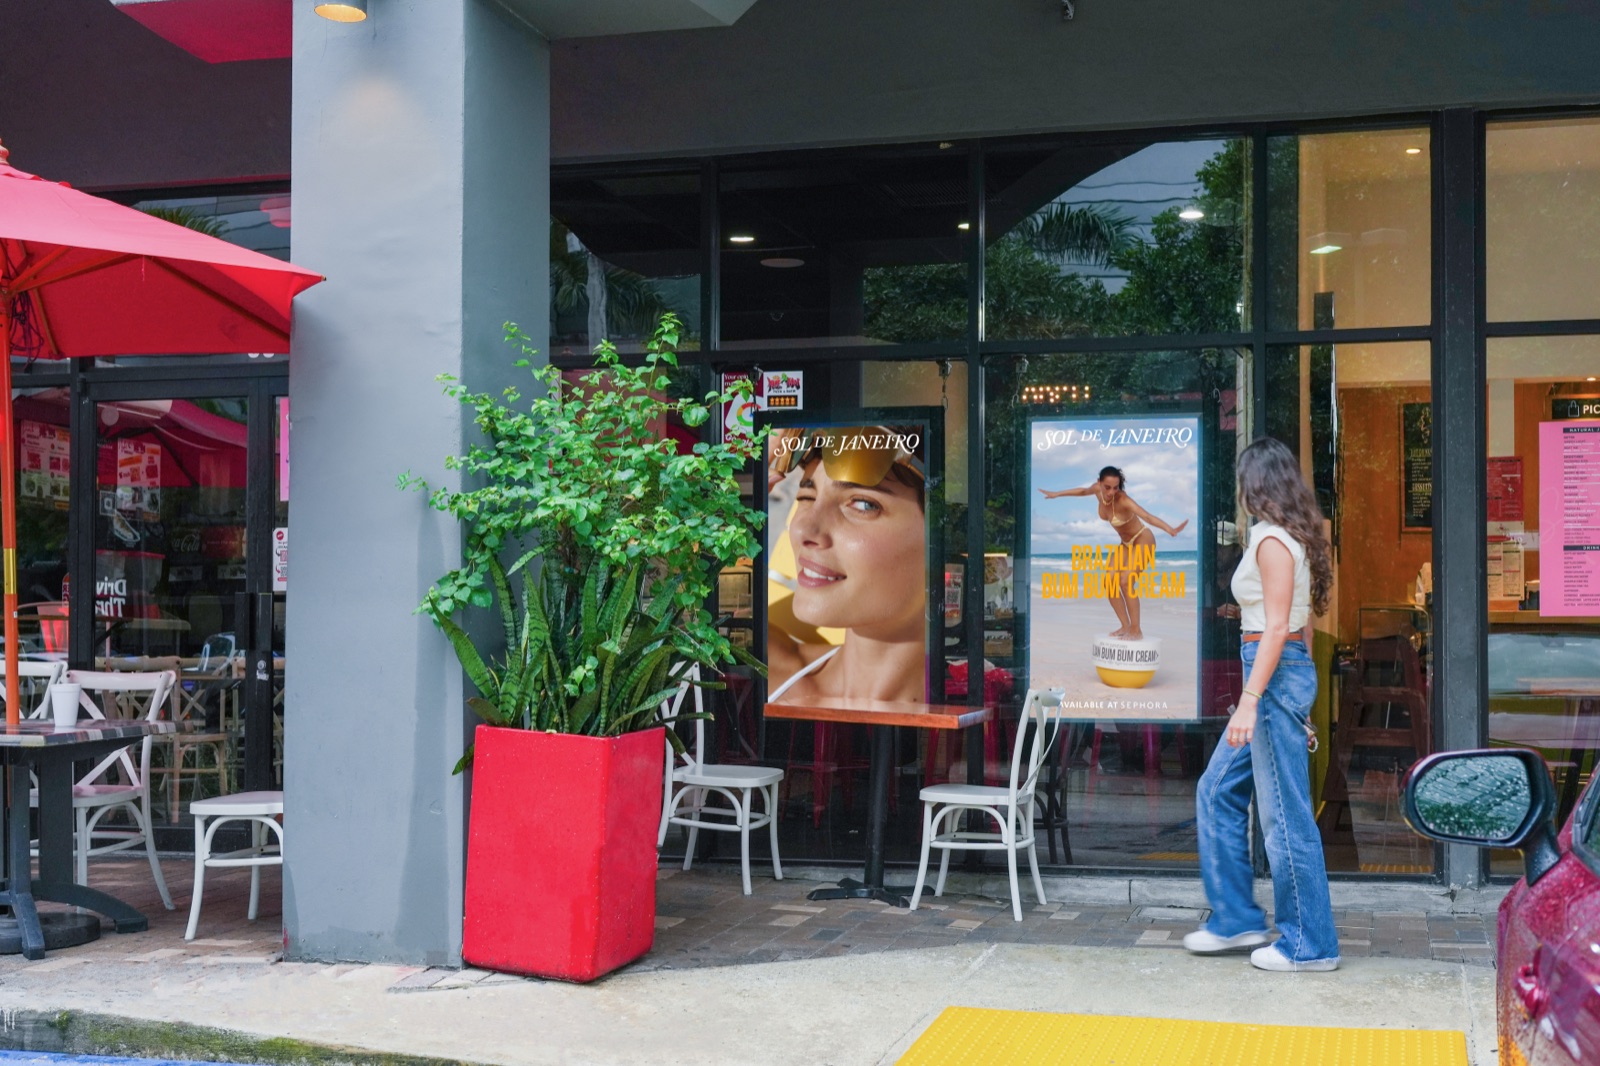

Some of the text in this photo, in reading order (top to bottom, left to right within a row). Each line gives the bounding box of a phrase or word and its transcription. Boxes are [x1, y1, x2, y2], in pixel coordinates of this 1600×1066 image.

[1583, 404, 1600, 415] PIC
[773, 433, 920, 457] SOL DE JANEIRO
[1037, 427, 1193, 451] SOL DE JANEIRO
[1071, 544, 1157, 571] BRAZILIAN
[1041, 571, 1185, 599] BUM BUM CREAM
[1101, 646, 1116, 660] BUM
[1117, 649, 1134, 662] BUM
[1060, 701, 1168, 710] AVAILABLE AT SEPHORA
